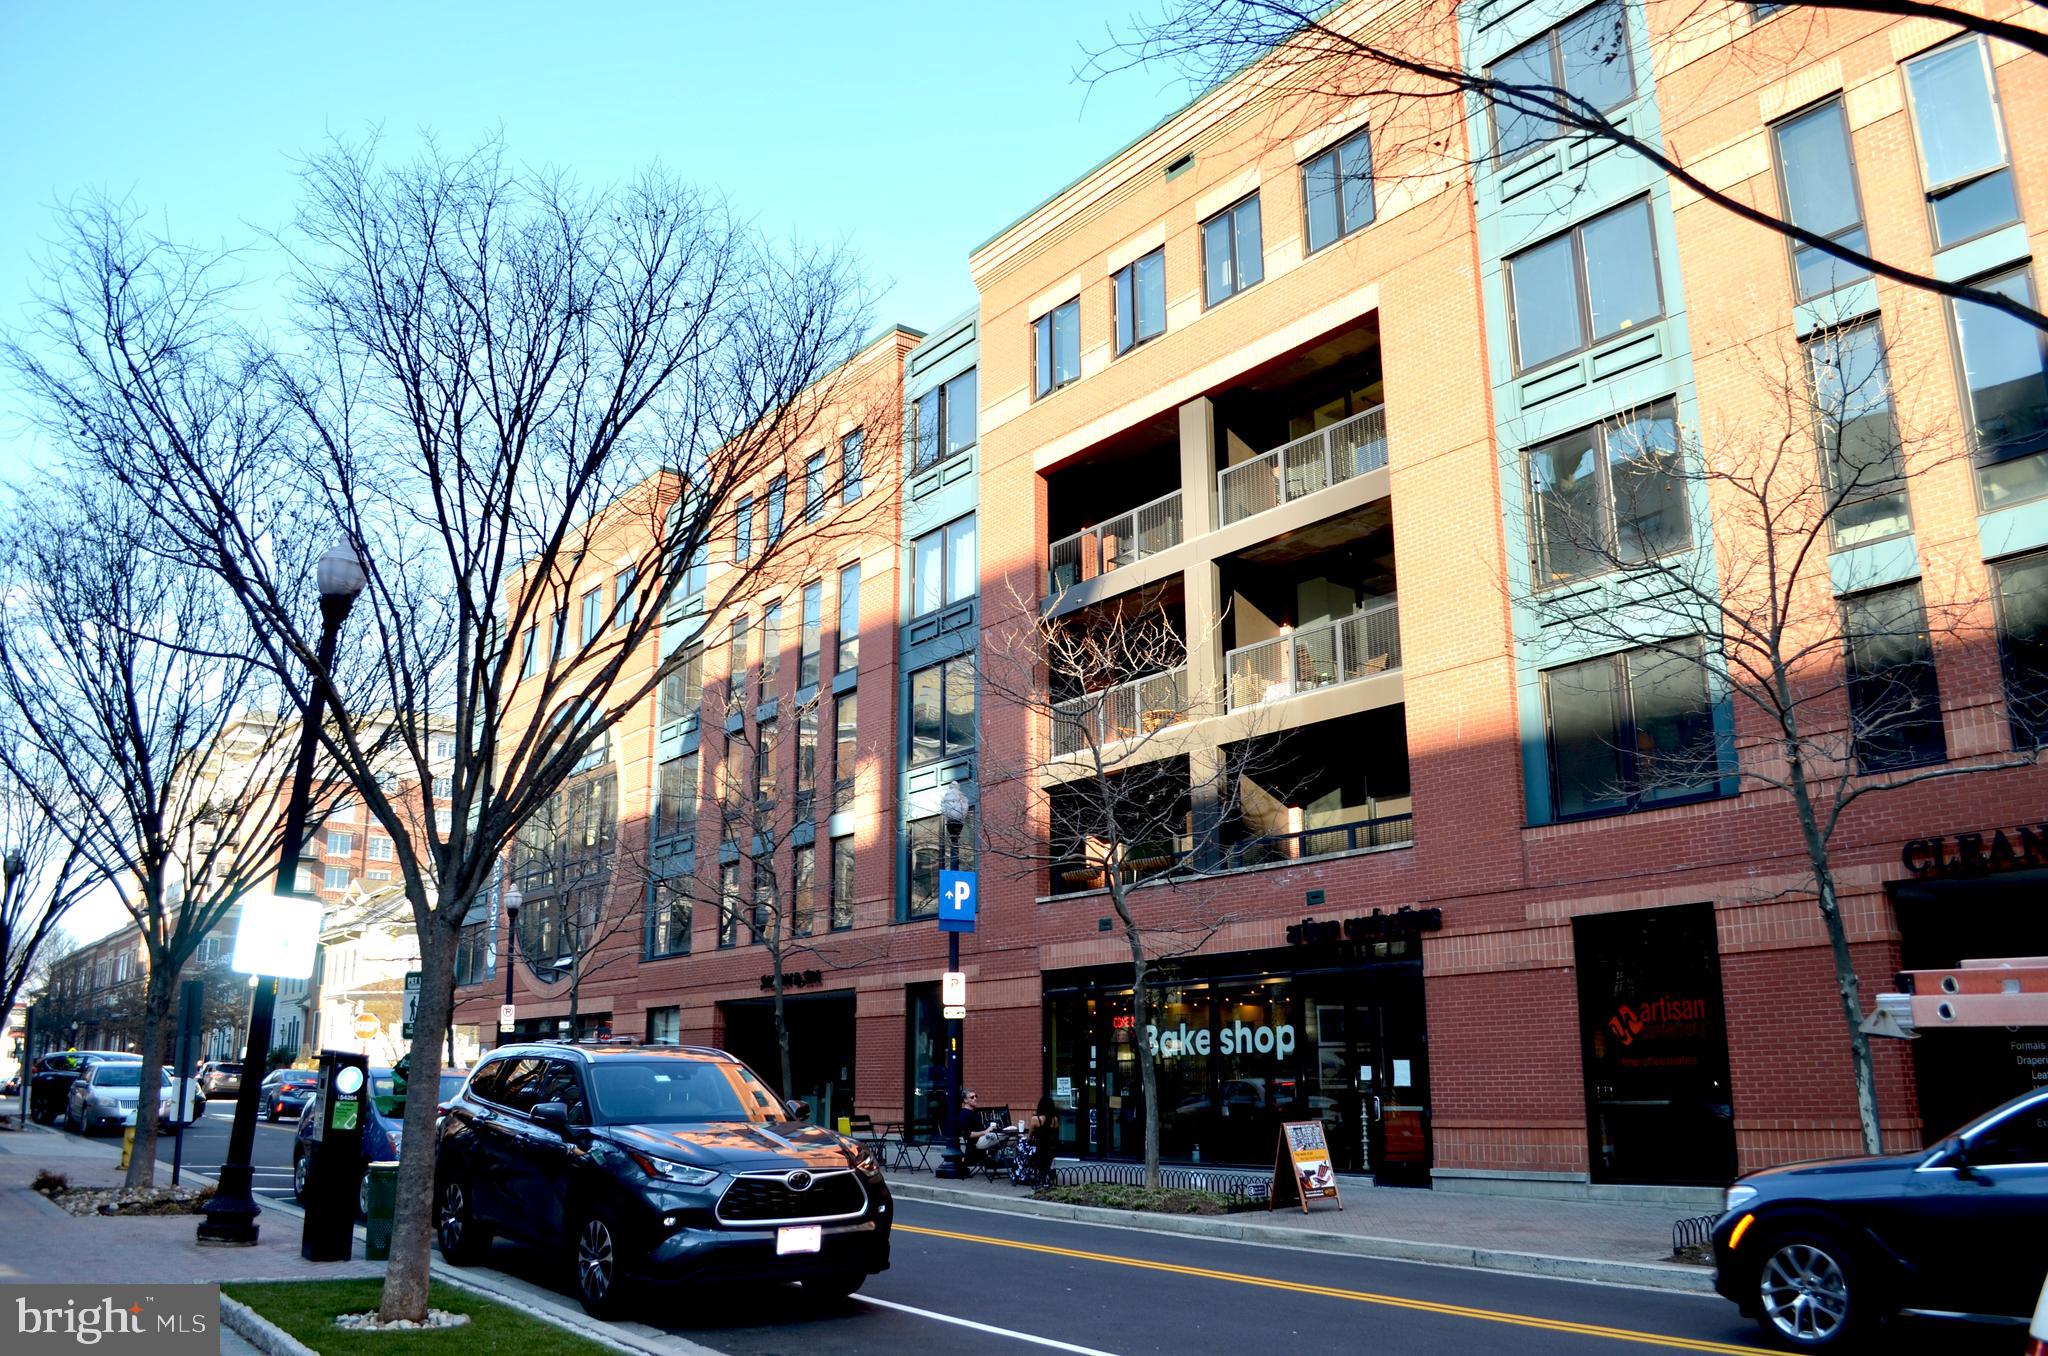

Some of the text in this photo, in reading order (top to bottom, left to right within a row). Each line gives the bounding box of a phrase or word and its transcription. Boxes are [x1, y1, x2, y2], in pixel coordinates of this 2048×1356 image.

[954, 880, 970, 910] P
[1640, 995, 1706, 1023] artisan
[1219, 1019, 1296, 1061] shop
[2010, 1040, 2047, 1051] Formals
